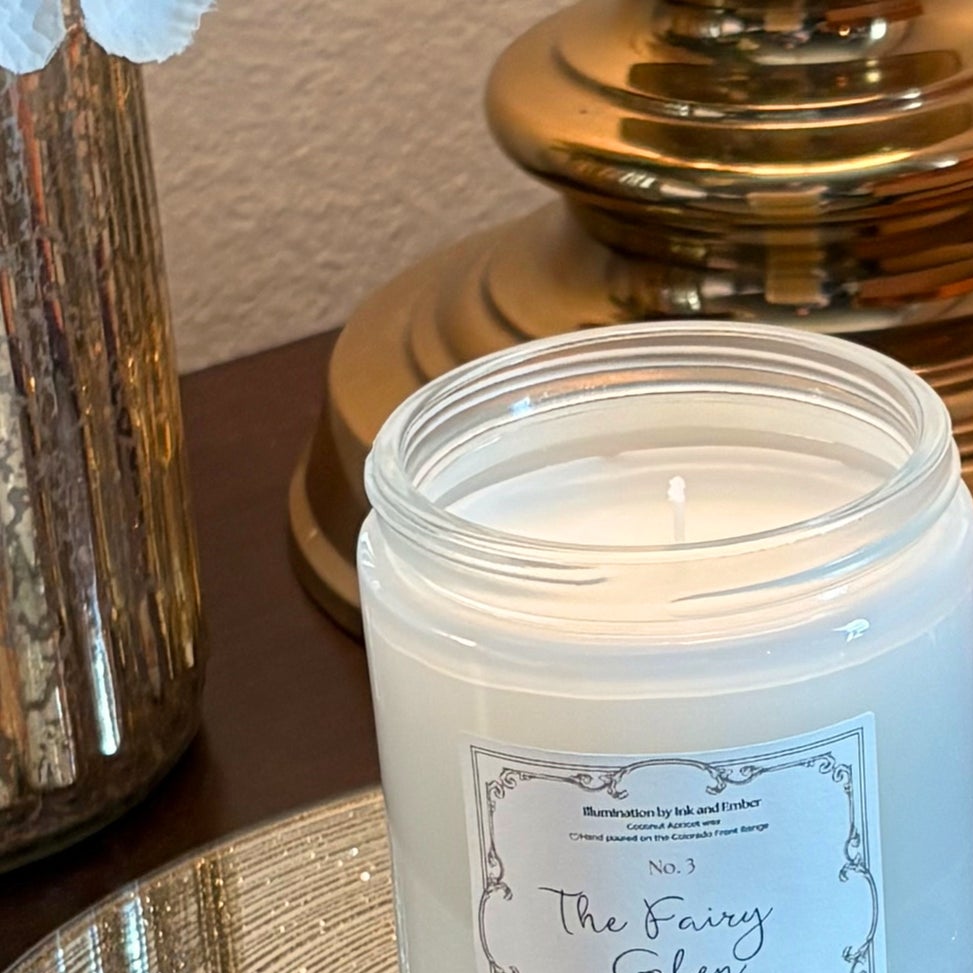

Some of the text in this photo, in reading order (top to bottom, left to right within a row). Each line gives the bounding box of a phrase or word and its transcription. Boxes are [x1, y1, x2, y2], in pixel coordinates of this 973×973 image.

[583, 798, 762, 819] Illumination by Ink and Ember
[580, 833, 604, 841] Hand
[606, 834, 638, 843] poured
[654, 833, 670, 841] the
[671, 831, 713, 841] Colorado
[714, 827, 738, 837] Front
[740, 823, 769, 832] Range
[626, 822, 665, 830] Coconut
[667, 820, 700, 830] Apricot
[648, 858, 696, 875] No. 3
[538, 887, 773, 961] The Fairy
